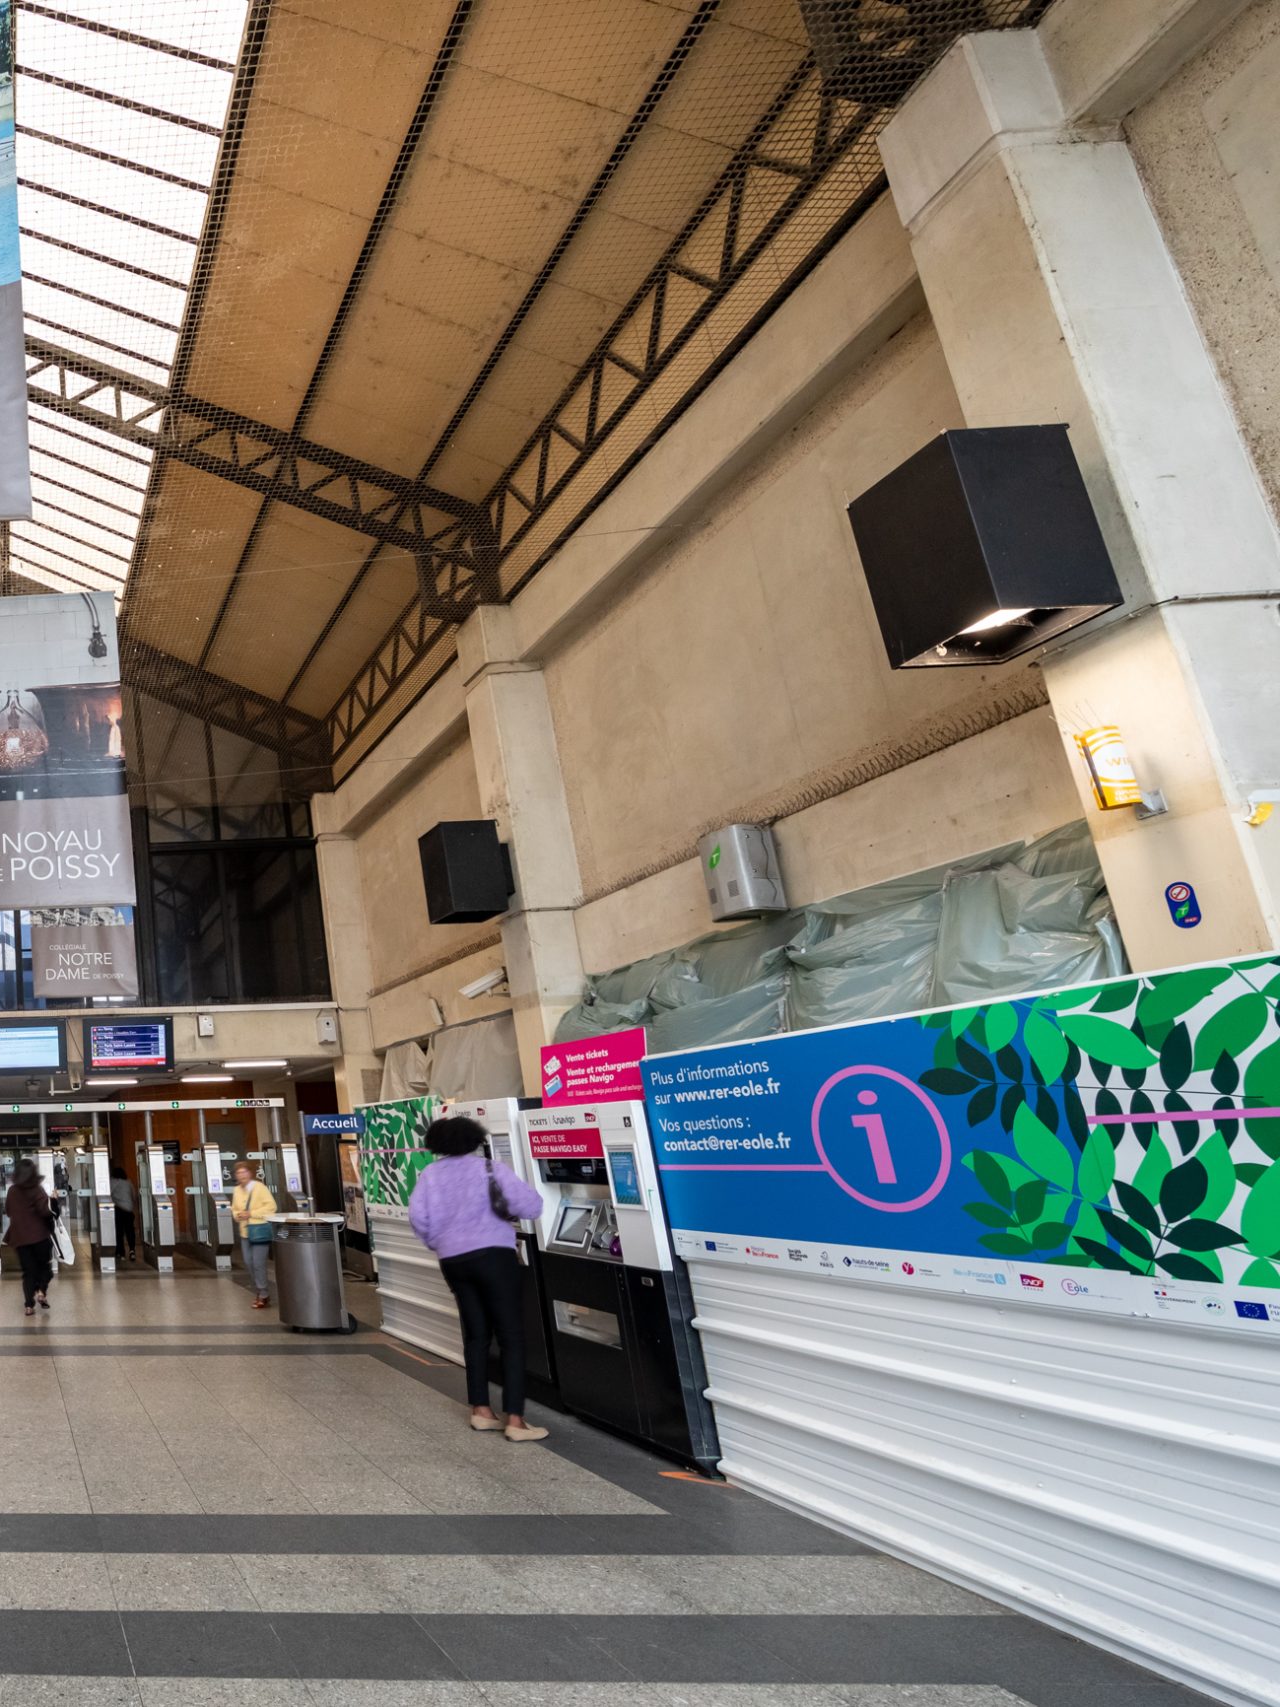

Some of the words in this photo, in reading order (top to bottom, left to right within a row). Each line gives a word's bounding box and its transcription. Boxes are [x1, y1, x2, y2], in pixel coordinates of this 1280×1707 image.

[2, 829, 102, 854] NOYAU
[10, 853, 120, 881] POISSY
[59, 952, 113, 966] NOTRE
[45, 967, 90, 981] DAME
[565, 1053, 585, 1062] Vente
[586, 1049, 608, 1060] tickets
[566, 1067, 585, 1076] Vente
[586, 1066, 594, 1074] et
[595, 1060, 640, 1073] rechargemen
[650, 1071, 674, 1086] Plus
[676, 1060, 770, 1083] d'informations
[567, 1077, 588, 1088] passes
[589, 1073, 615, 1083] Navigo
[654, 1093, 671, 1105] sur
[674, 1077, 781, 1103] www.rer-eole.fr
[312, 1117, 359, 1129] Accueil
[658, 1118, 681, 1132] Vos
[683, 1115, 744, 1135] questions
[541, 1134, 558, 1142] VENTE
[558, 1134, 566, 1142] DE
[664, 1132, 792, 1151] contact@rer-eole.fr
[534, 1145, 550, 1153] PASSE
[550, 1145, 572, 1153] NAVIGO
[573, 1144, 588, 1152] EASY
[1022, 1278, 1043, 1287] SNCF
